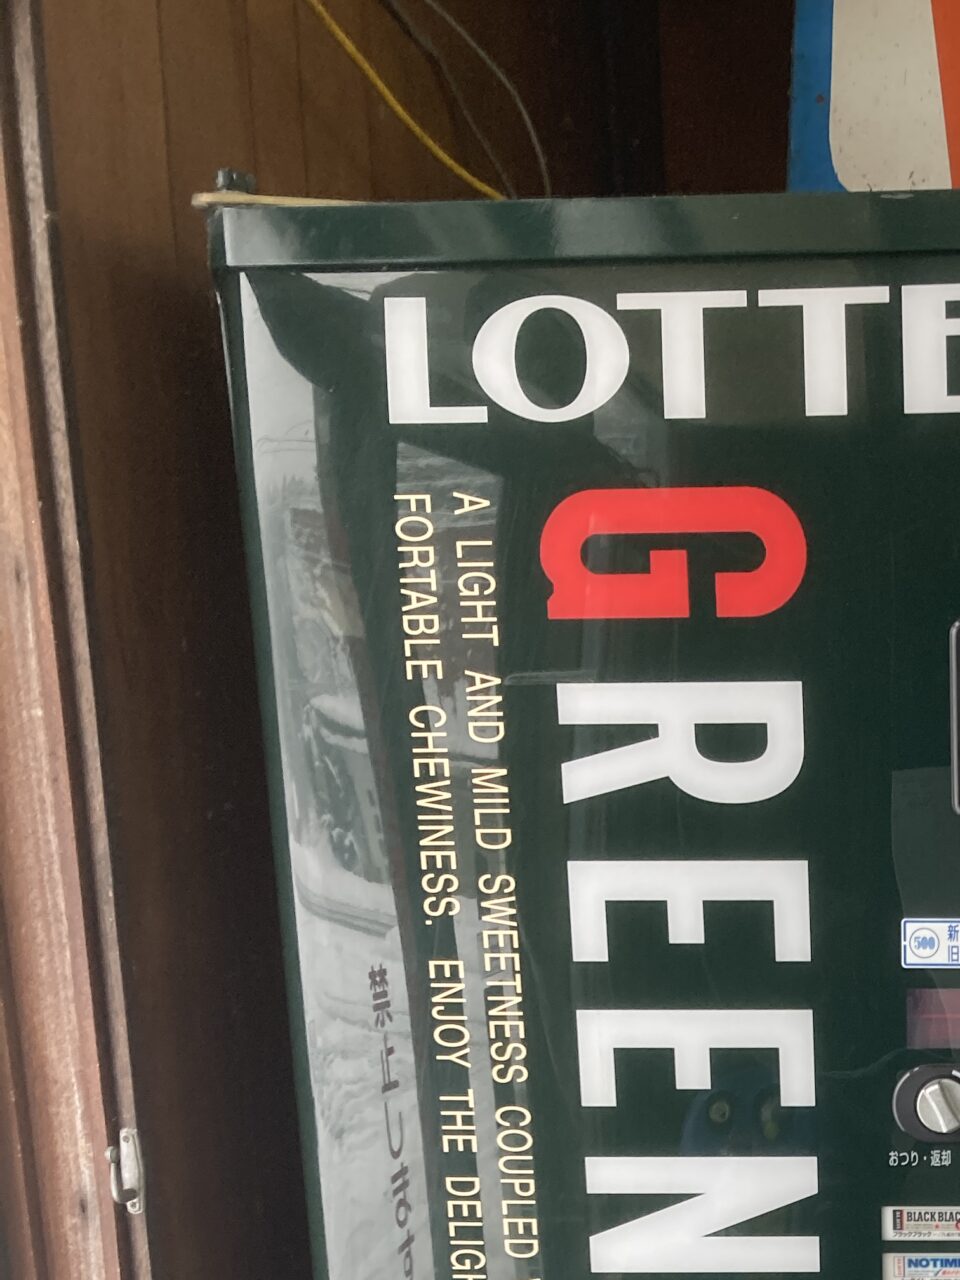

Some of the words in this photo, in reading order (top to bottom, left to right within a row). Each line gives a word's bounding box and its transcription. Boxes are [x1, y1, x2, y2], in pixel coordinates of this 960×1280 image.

[452, 490, 491, 516] A
[393, 493, 444, 681] FORTABLE
[455, 540, 500, 646] LIGHT
[464, 669, 506, 744] AND
[407, 703, 462, 927] CHEWINESS.
[471, 768, 513, 850] MILD
[539, 485, 821, 1273] GREEN
[427, 958, 472, 1069] ENJOY
[477, 872, 529, 1084] SWEETNESS
[438, 1090, 479, 1154] THE
[495, 1105, 540, 1260] COUPLED
[906, 1210, 935, 1222] BLACK
